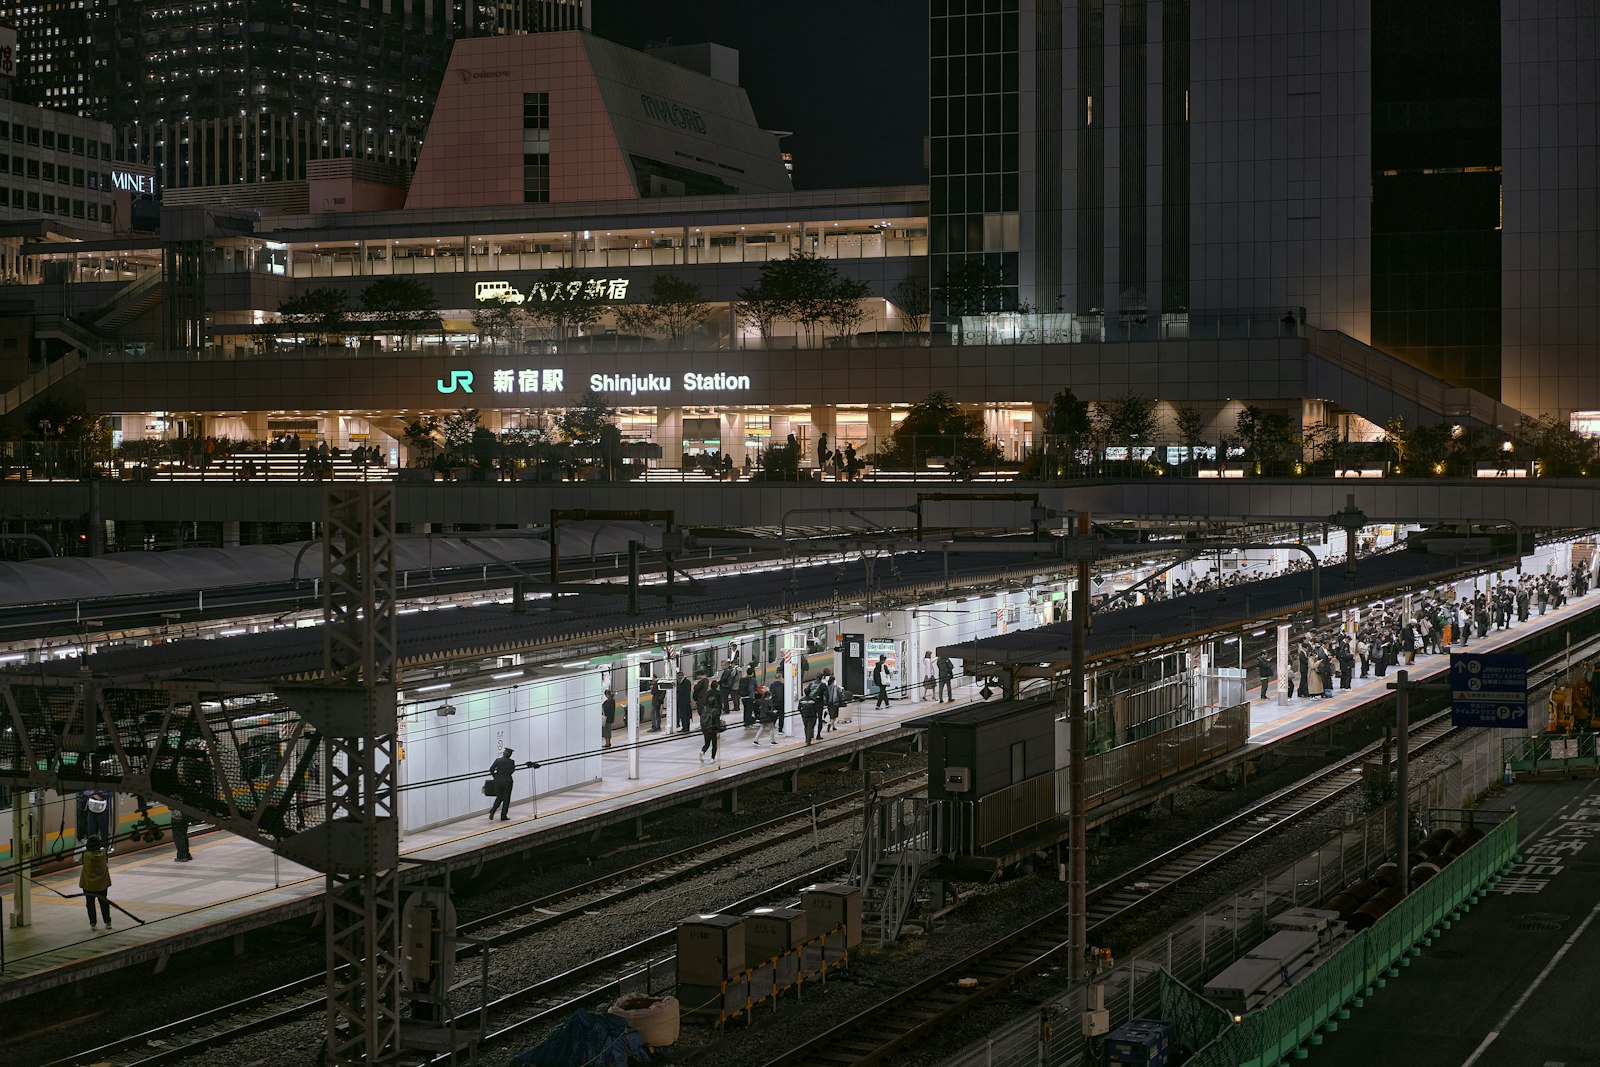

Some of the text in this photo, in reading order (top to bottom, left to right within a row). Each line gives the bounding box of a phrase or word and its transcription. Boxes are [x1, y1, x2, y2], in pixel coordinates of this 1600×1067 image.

[527, 278, 629, 302] バスタ新宿
[437, 369, 750, 396] JR 新宿駅 Shinjuku Station
